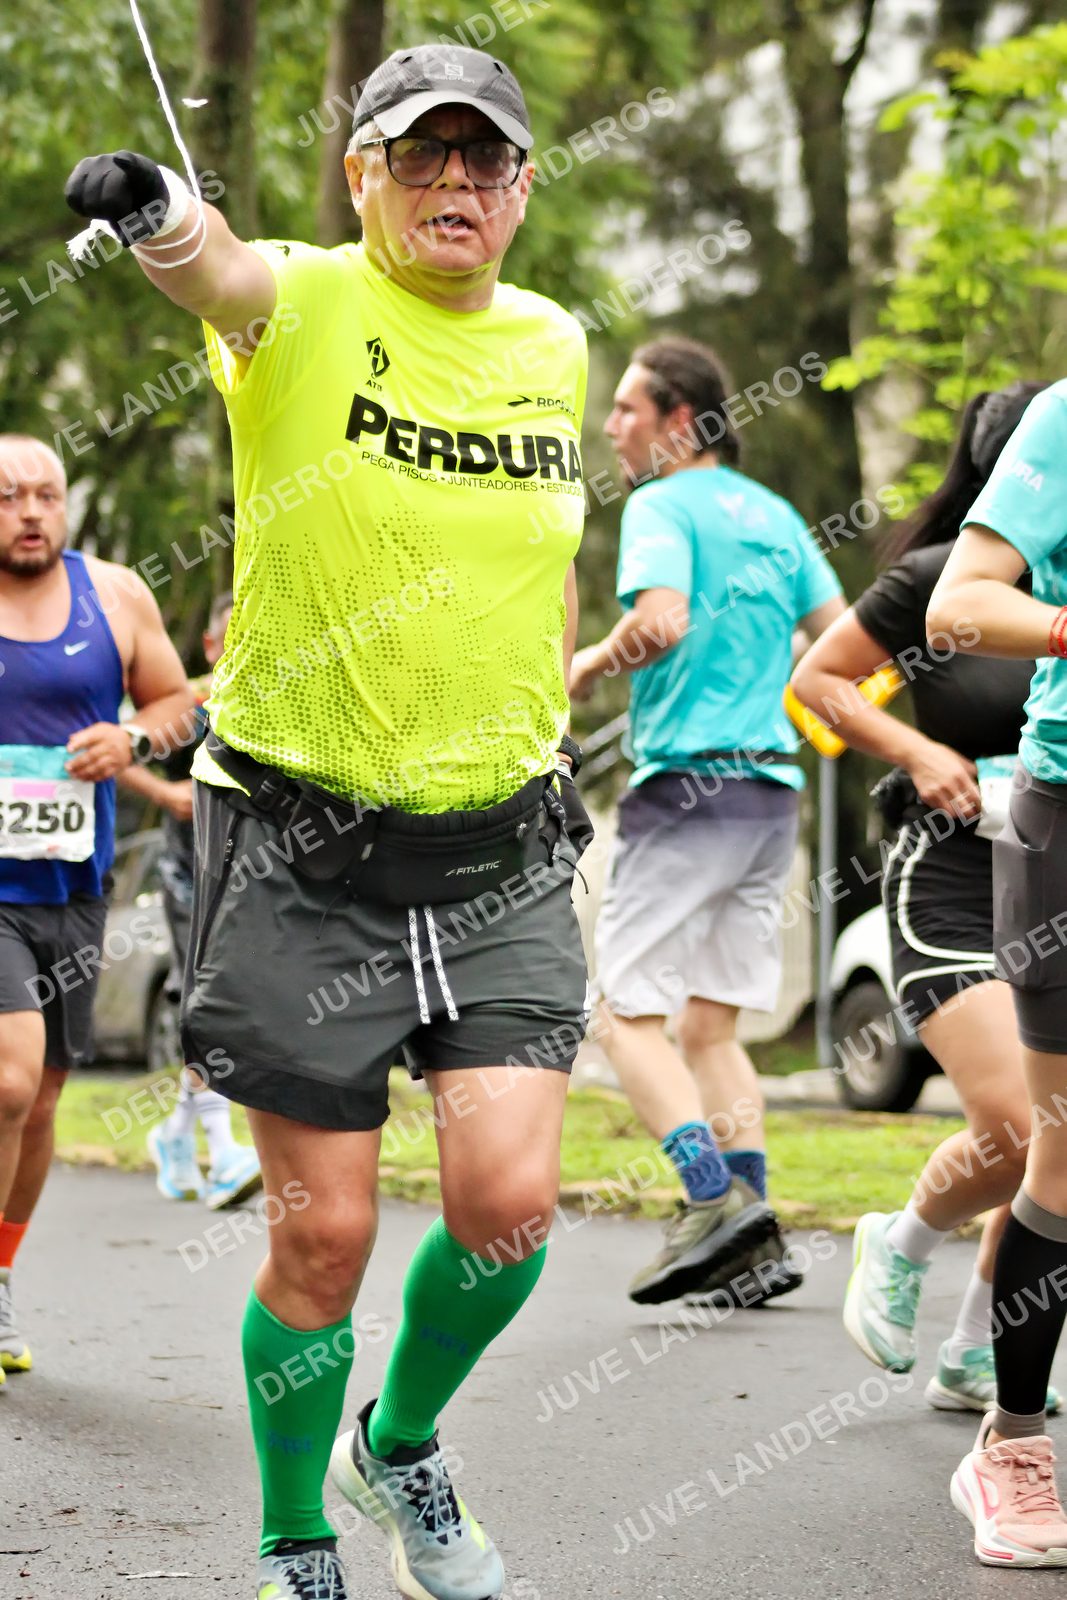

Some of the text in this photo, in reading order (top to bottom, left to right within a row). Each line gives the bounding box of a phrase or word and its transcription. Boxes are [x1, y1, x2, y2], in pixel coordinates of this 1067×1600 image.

[345, 393, 583, 483] PERDURA
[361, 451, 395, 473] PEGA
[398, 465, 438, 483] PISOS
[446, 476, 538, 493] JUNTEADORES
[0, 801, 85, 833] 250
[456, 860, 500, 876] FITLETIC
